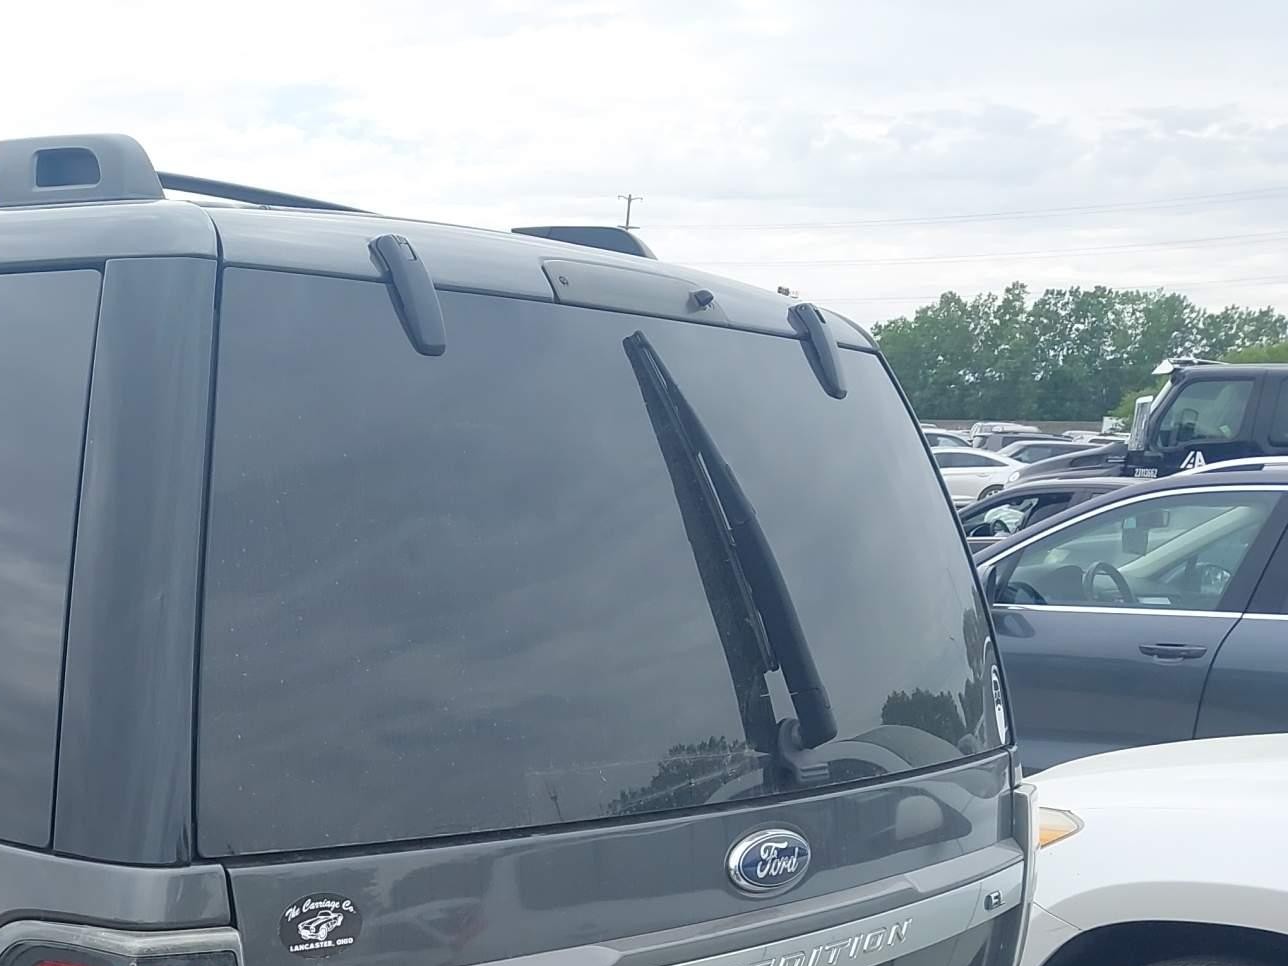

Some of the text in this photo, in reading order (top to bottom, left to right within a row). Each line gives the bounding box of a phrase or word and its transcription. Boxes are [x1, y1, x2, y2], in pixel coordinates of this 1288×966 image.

[756, 841, 799, 878] Ford
[285, 905, 300, 922] The
[302, 898, 340, 913] Carriage
[336, 937, 354, 946] OHIO
